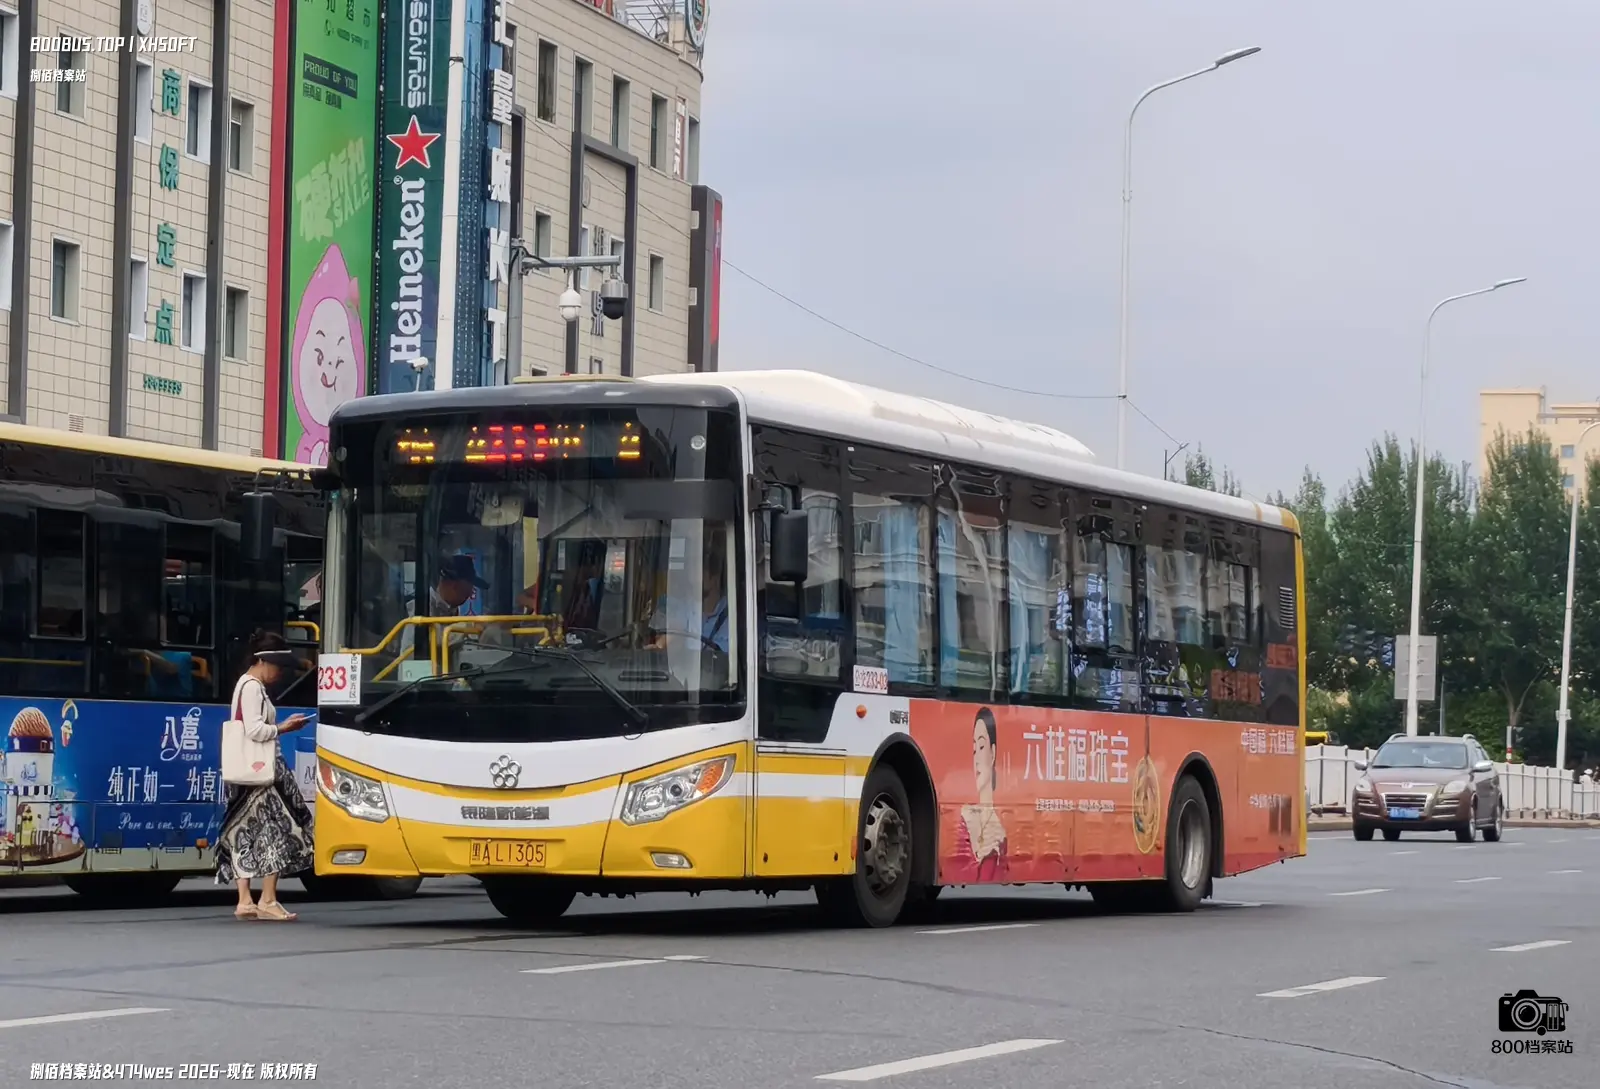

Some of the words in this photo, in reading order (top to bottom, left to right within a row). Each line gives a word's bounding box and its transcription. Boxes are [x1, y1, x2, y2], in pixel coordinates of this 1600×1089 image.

[304, 60, 330, 80] PROUD
[332, 70, 342, 84] OF
[344, 75, 357, 92] YOU
[407, 0, 428, 109] SOUNDS
[153, 67, 182, 346] 商保定点
[333, 173, 370, 229] SALE
[389, 176, 427, 363] Heineken
[318, 665, 347, 691] 233
[160, 706, 202, 762] 八喜
[1023, 724, 1130, 784] 六桂福珠宝
[107, 765, 175, 803] 纯正如一
[118, 811, 142, 830] Pure
